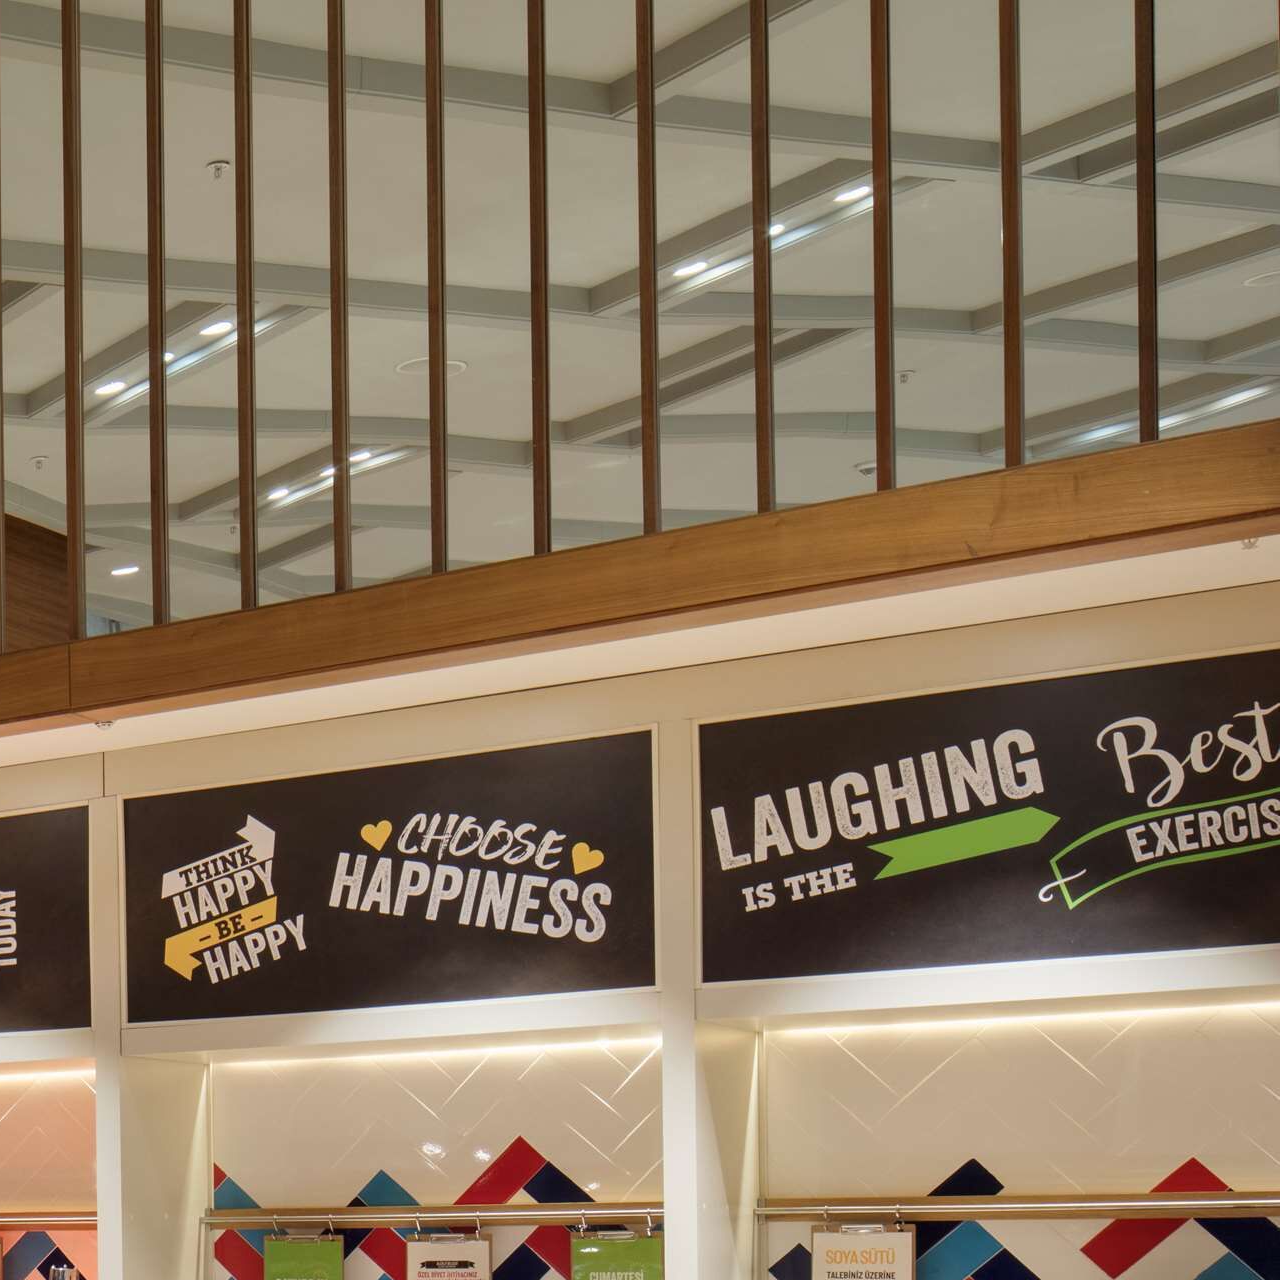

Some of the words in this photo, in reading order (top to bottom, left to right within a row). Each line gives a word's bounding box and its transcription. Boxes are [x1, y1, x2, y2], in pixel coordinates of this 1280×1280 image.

[1096, 700, 1280, 807] Best
[710, 729, 1045, 871] LAUGHING
[179, 844, 258, 887] THINK
[396, 812, 567, 871] CHOOSE
[172, 859, 276, 929] HAPPY
[328, 851, 613, 943] HAPPINESS
[741, 882, 777, 912] IS
[783, 862, 857, 903] THE
[203, 914, 308, 984] HAPPY
[217, 913, 246, 938] BE
[826, 1249, 858, 1265] SOYA
[861, 1248, 896, 1265] SÜTÜ
